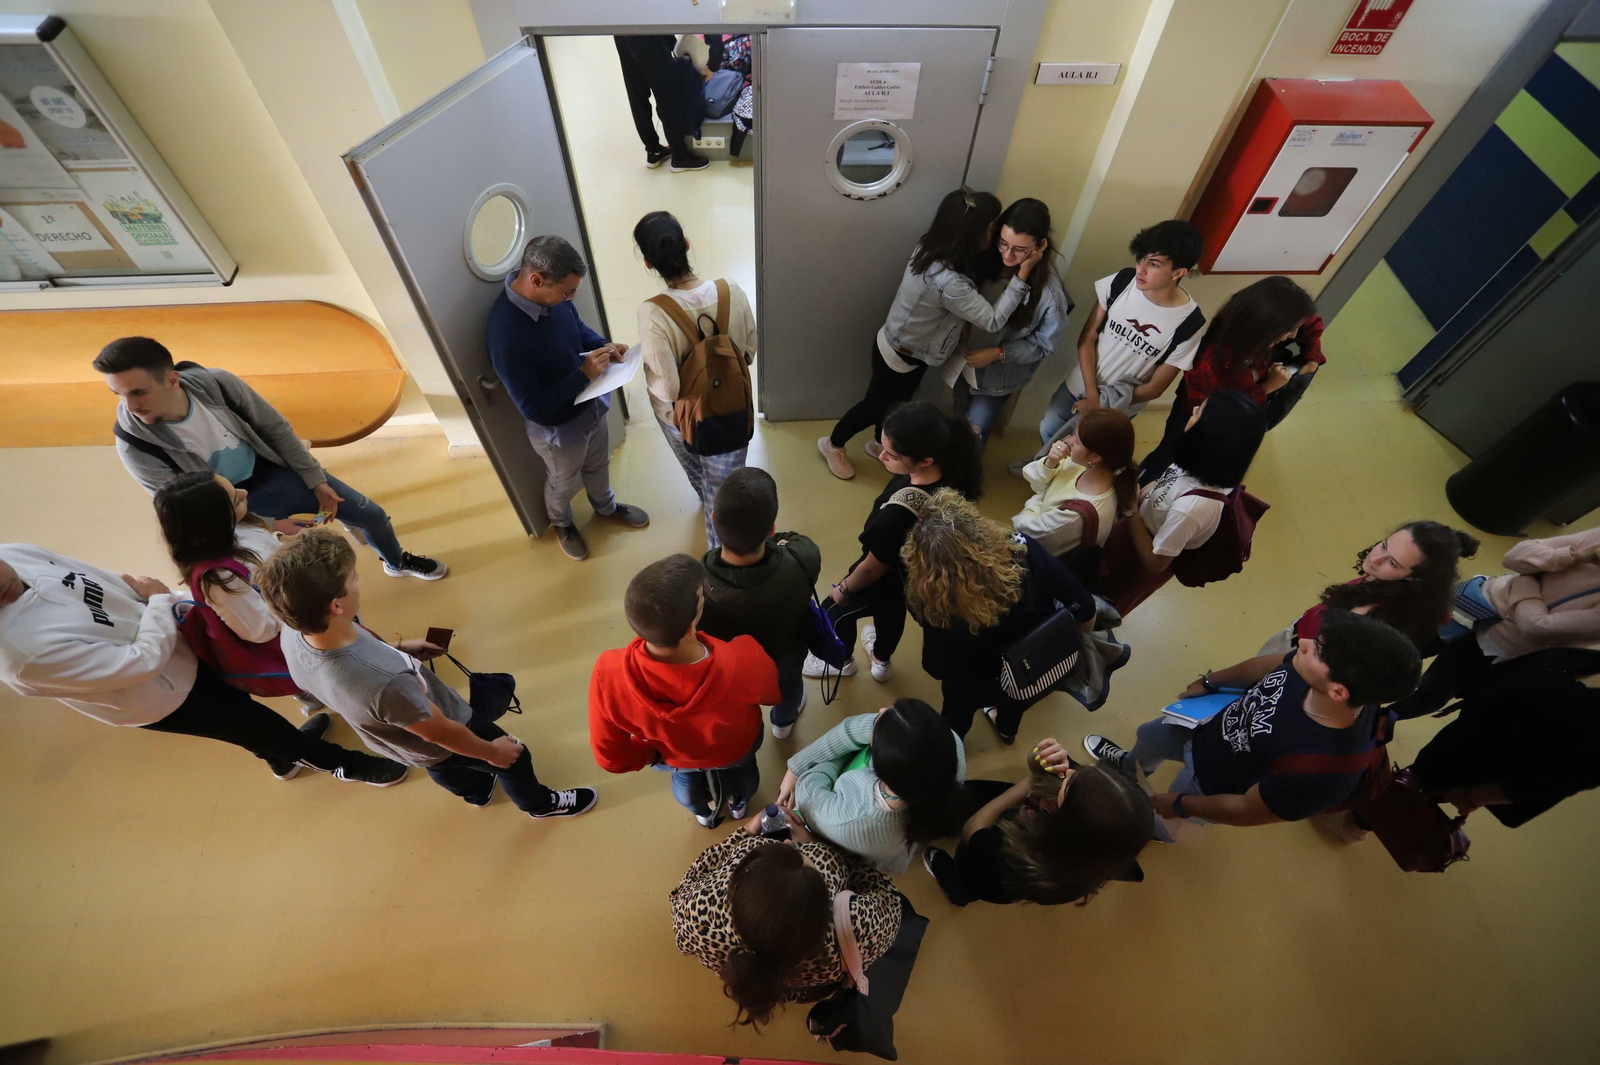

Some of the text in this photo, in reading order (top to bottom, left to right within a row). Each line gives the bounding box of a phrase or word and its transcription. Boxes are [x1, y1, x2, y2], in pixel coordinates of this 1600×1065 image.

[1340, 32, 1390, 43] BOCA DE
[1333, 44, 1382, 54] INCENDIO
[1058, 71, 1099, 79] AULA B.1
[34, 230, 92, 243] DERECHO
[1109, 319, 1161, 358] HOLLISTER
[81, 577, 115, 628] PUMA
[1250, 670, 1288, 737] GYM
